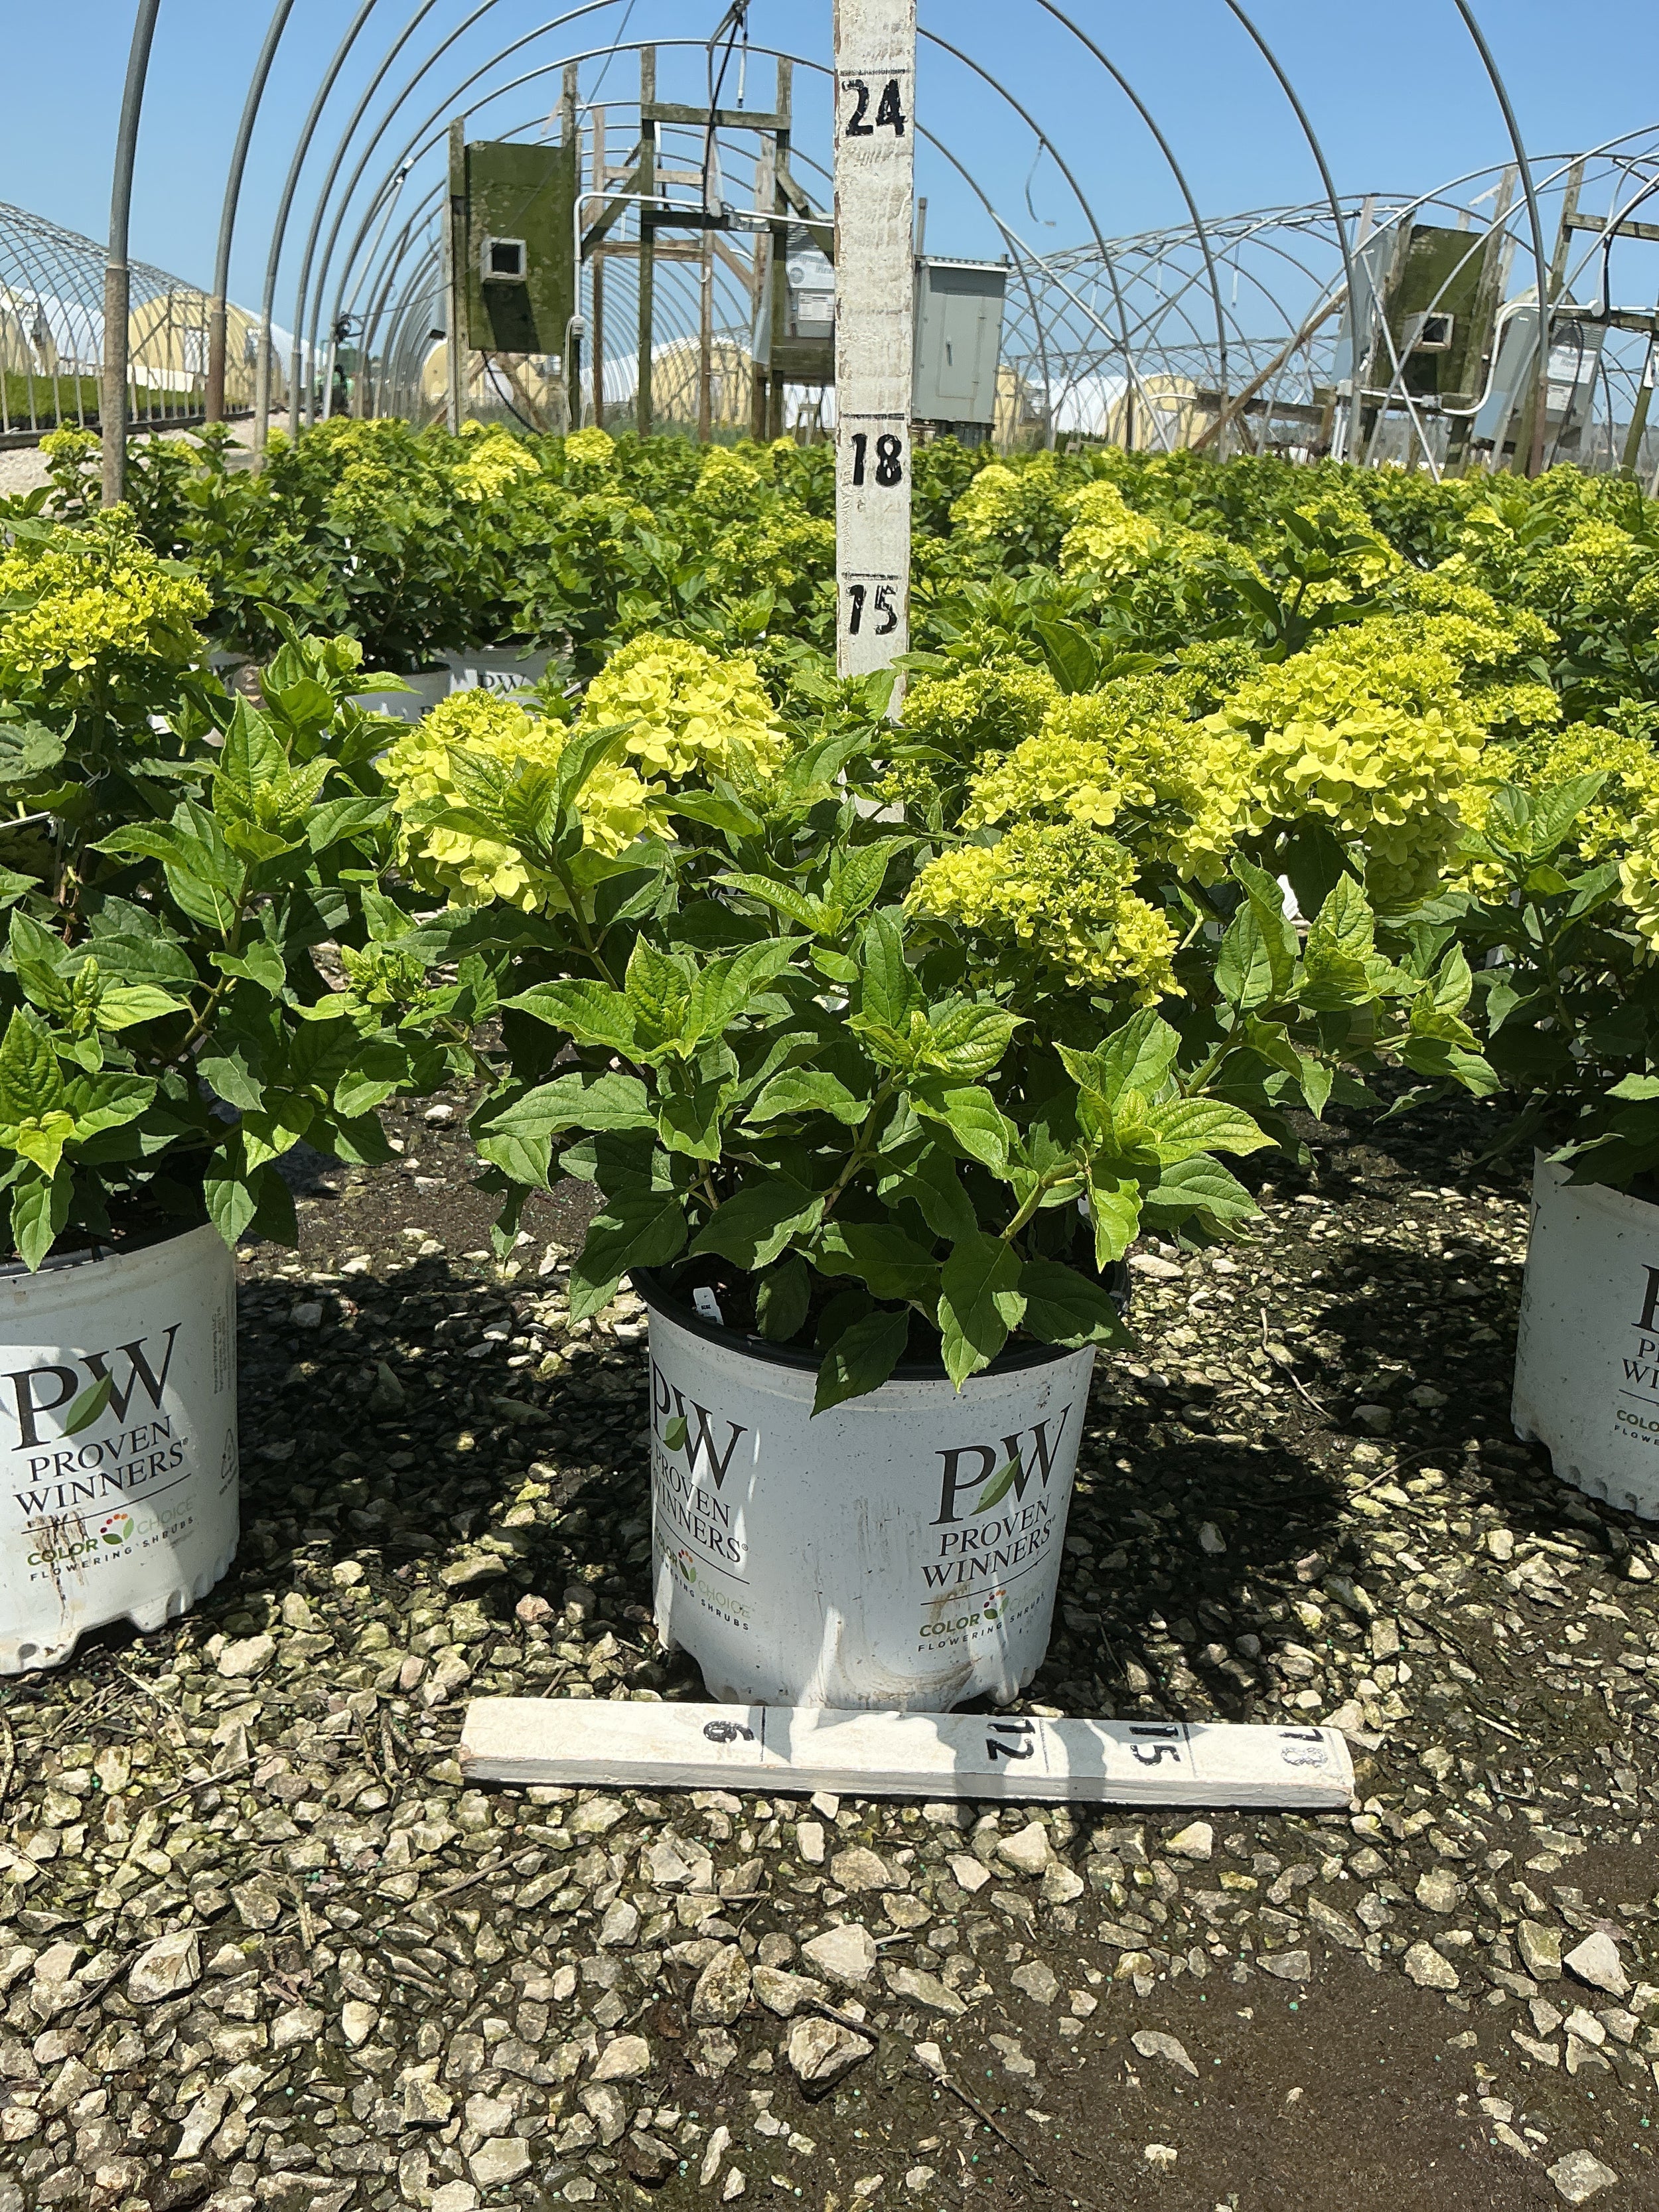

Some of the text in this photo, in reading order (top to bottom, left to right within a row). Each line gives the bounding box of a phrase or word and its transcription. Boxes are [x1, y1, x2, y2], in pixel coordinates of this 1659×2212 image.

[841, 78, 908, 137] 24
[851, 433, 903, 487] 18
[845, 584, 899, 635] 15
[1, 1323, 182, 1452] PW
[650, 1355, 749, 1491] PW
[1617, 1410, 1659, 1432] COLO
[27, 1415, 172, 1483] PROVEN
[928, 1402, 1073, 1525] PW
[655, 1443, 731, 1528] PROVEN
[27, 1497, 194, 1566] COLOR CHOICE
[30, 1516, 194, 1582] FLOWERING SHRUBS
[938, 1494, 1051, 1558] PROVEN
[697, 1580, 751, 1619] CHOICE
[700, 1598, 749, 1631] SHRUBS
[919, 1613, 981, 1637] COLOR
[918, 1621, 1003, 1653] FLOWERING
[703, 1720, 755, 1744] 6
[986, 1718, 1036, 1761] 12
[1129, 1726, 1182, 1767] 15
[1278, 1728, 1329, 1769] 18
